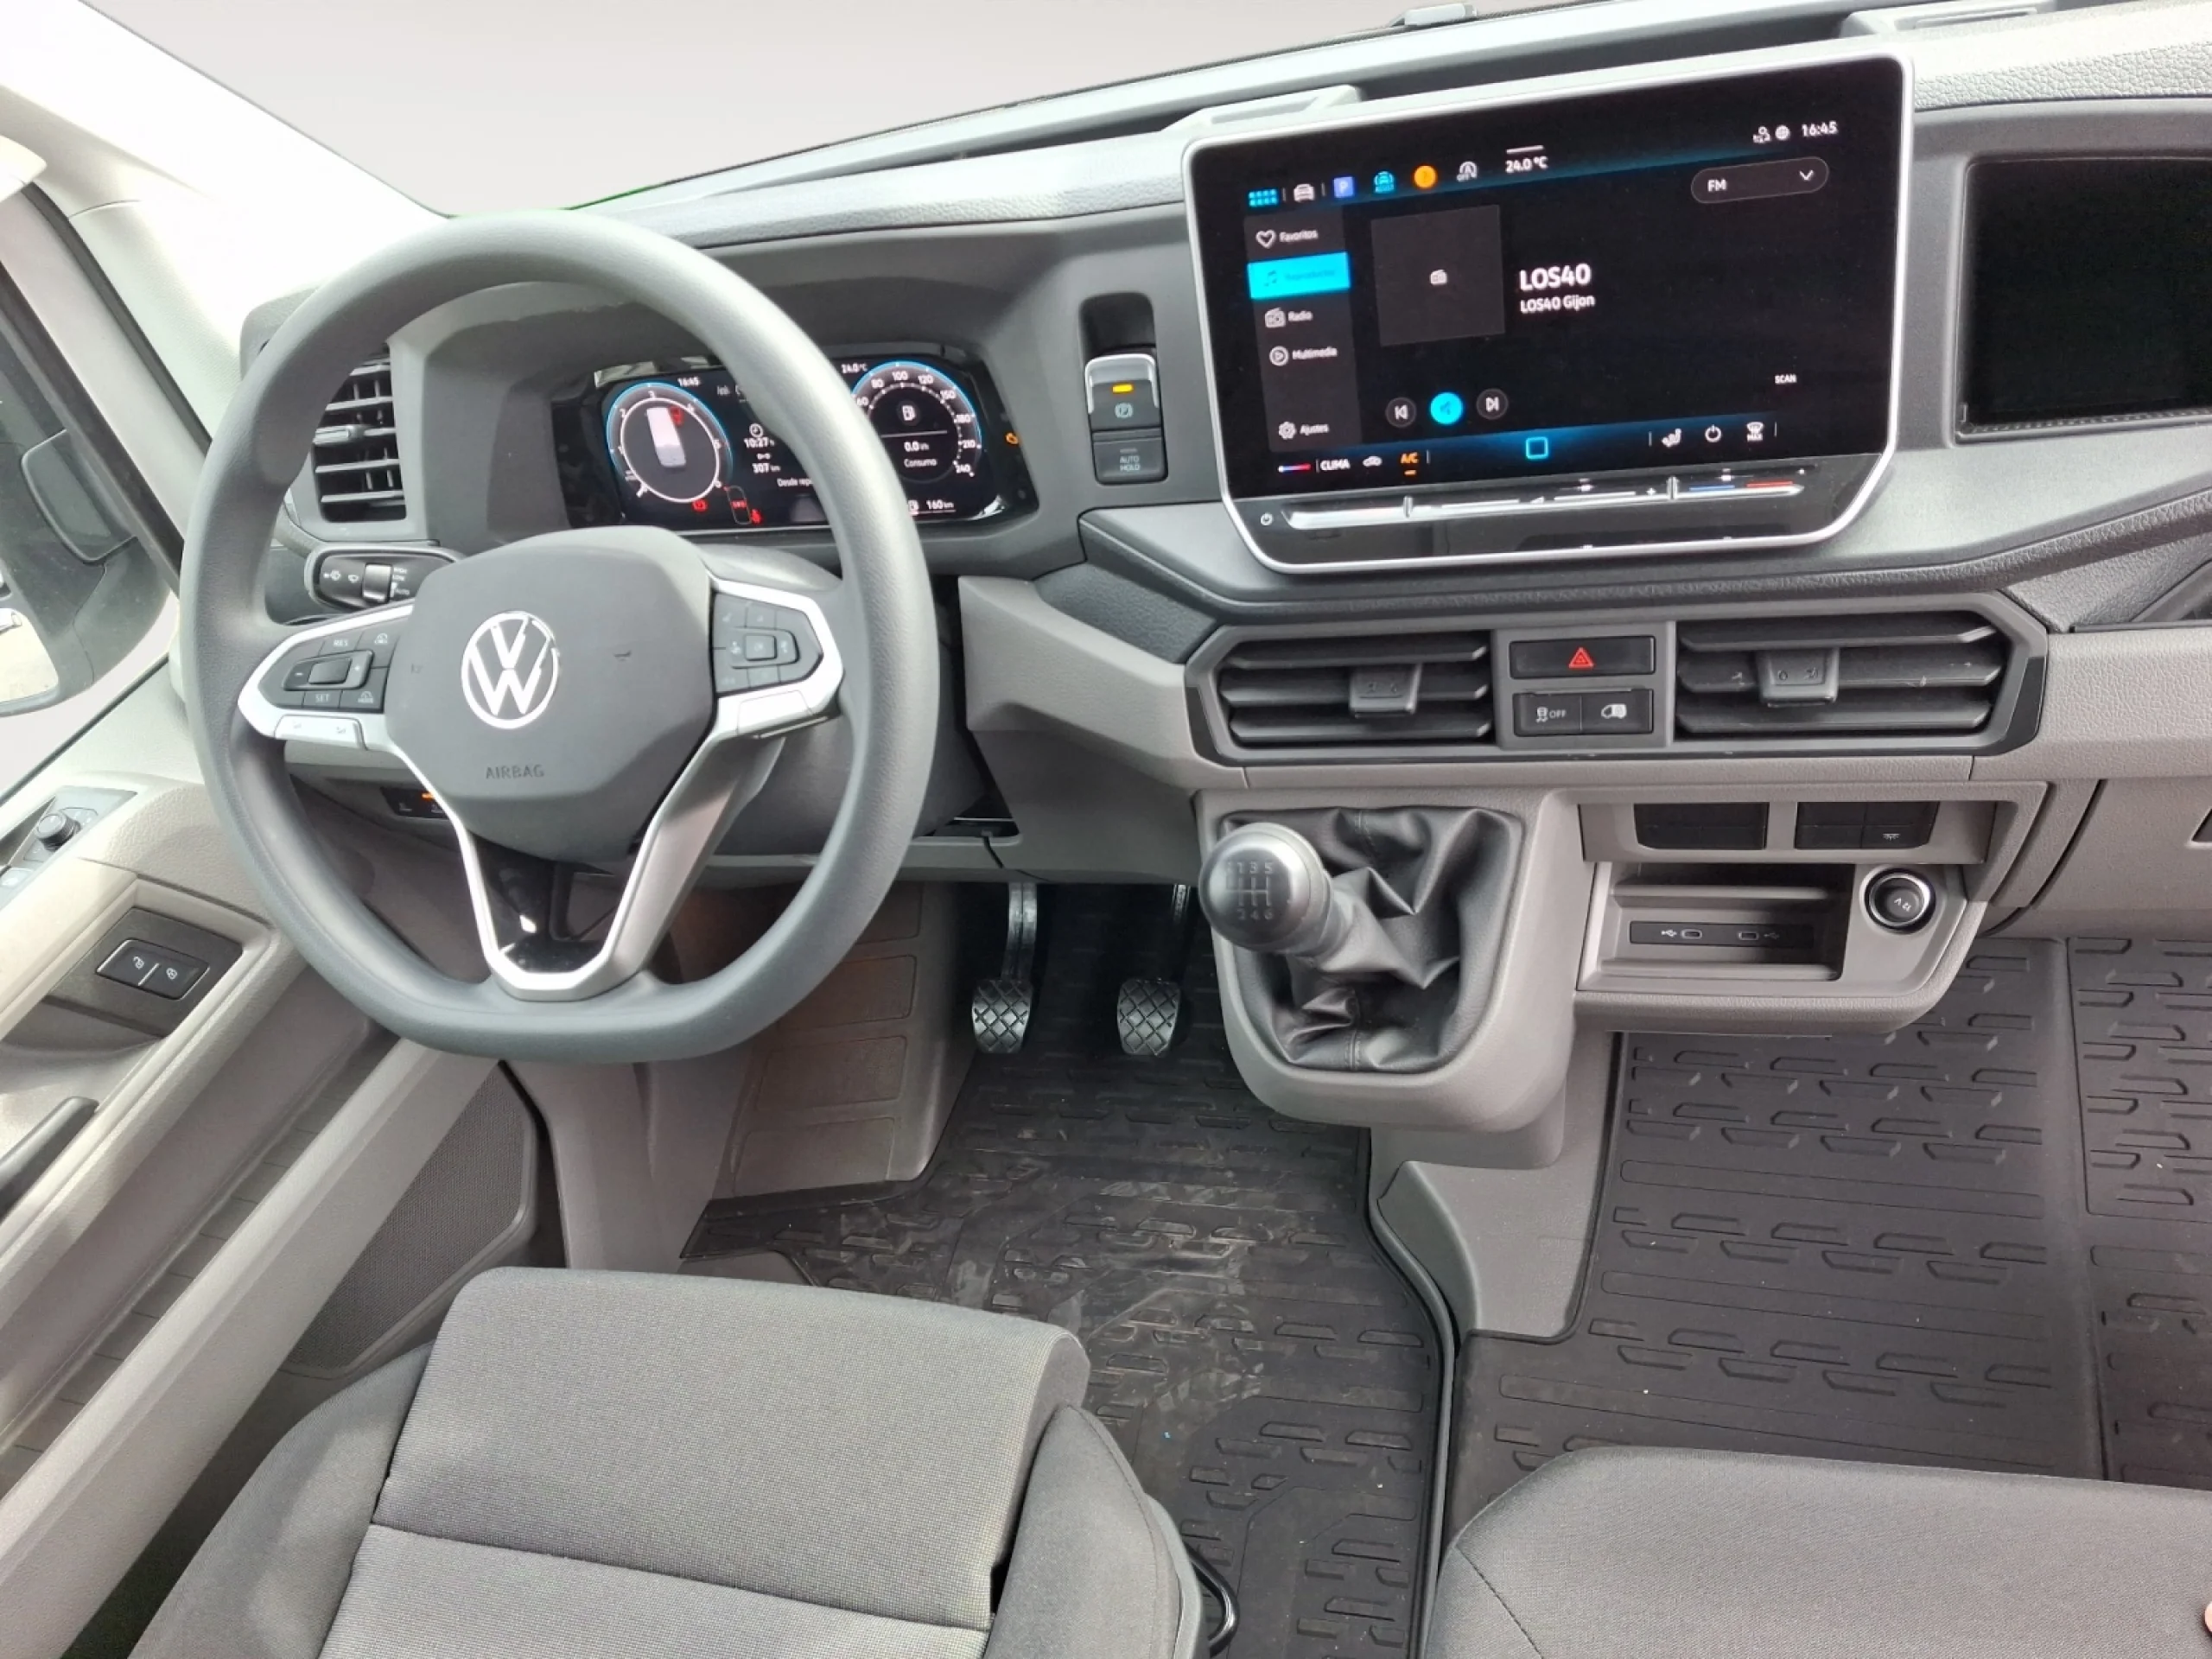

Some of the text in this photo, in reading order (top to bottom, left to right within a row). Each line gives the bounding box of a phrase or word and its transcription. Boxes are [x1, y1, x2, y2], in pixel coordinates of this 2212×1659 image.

[1802, 120, 1837, 137] 16:45
[1505, 158, 1532, 173] 24.0
[1707, 179, 1726, 192] FM
[1279, 230, 1318, 242] Favoritos
[1520, 263, 1592, 291] LOS40
[1520, 295, 1596, 314] LOS40 Gijon
[1287, 310, 1313, 321] Radio
[892, 371, 908, 381] 100
[918, 374, 934, 385] 120
[1774, 373, 1797, 385] SCAN
[871, 378, 885, 389] 80
[1300, 423, 1330, 435] Ajustes
[904, 458, 938, 467] Consumo
[1400, 452, 1419, 464] A/C
[1120, 463, 1141, 472] HOLD
[1319, 458, 1351, 471] CLIMA
[333, 639, 349, 647] RES
[315, 693, 330, 702] SET
[1549, 709, 1567, 719] OFF
[486, 764, 544, 780] AIRBAG
